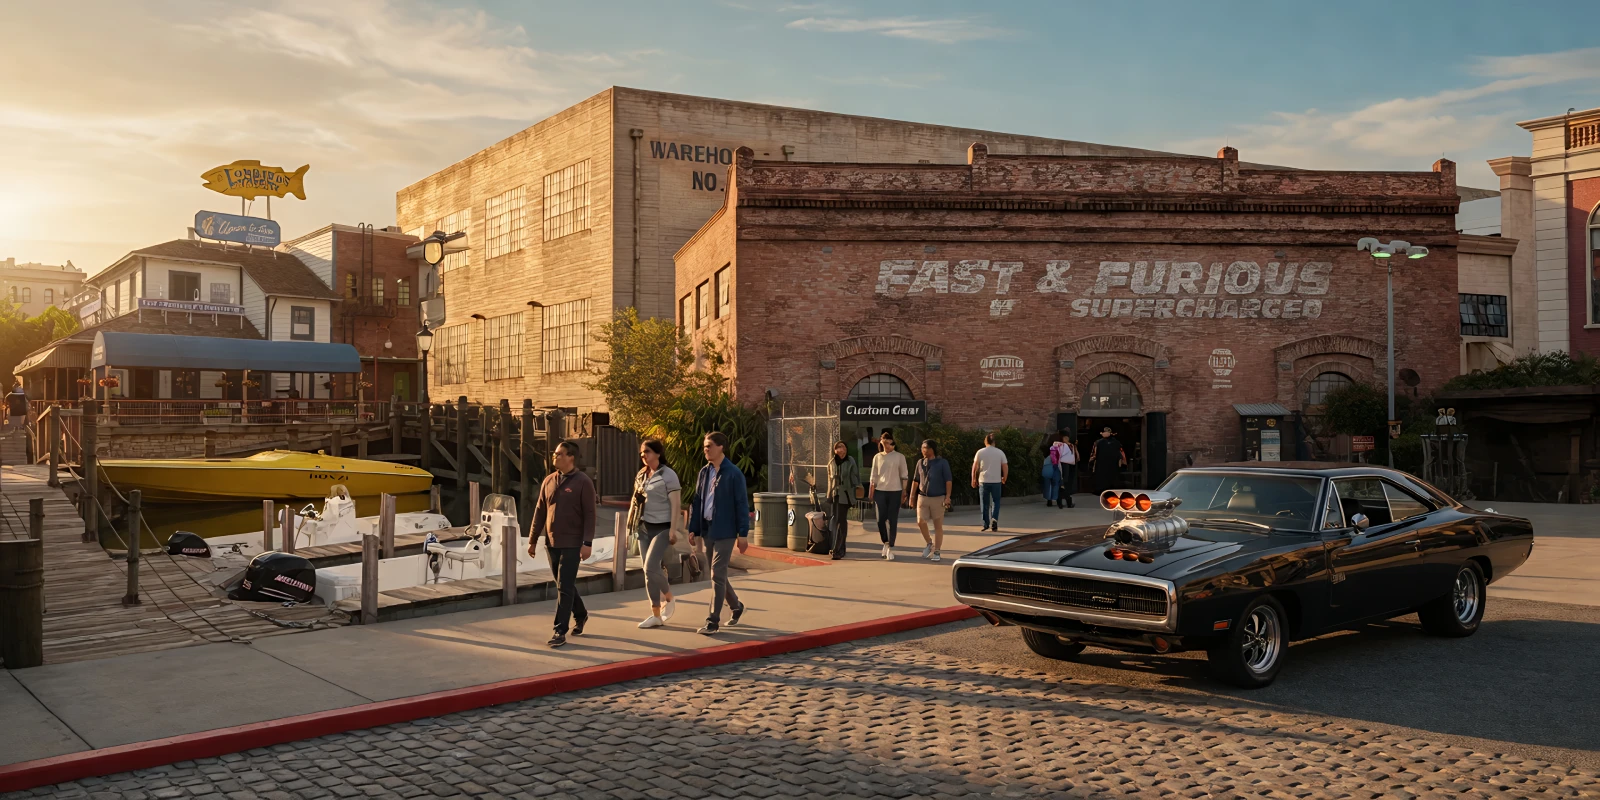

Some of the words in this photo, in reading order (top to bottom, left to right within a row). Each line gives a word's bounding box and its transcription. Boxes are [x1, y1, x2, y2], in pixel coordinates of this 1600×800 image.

[650, 140, 733, 165] WAREHO
[692, 170, 725, 192] NO.
[874, 259, 1024, 295] FAST
[1034, 259, 1073, 293] &
[1084, 260, 1333, 295] FURIOUS
[1069, 298, 1323, 319] SUPERCHARGED
[846, 405, 890, 415] Custom
[892, 405, 920, 415] Gear
